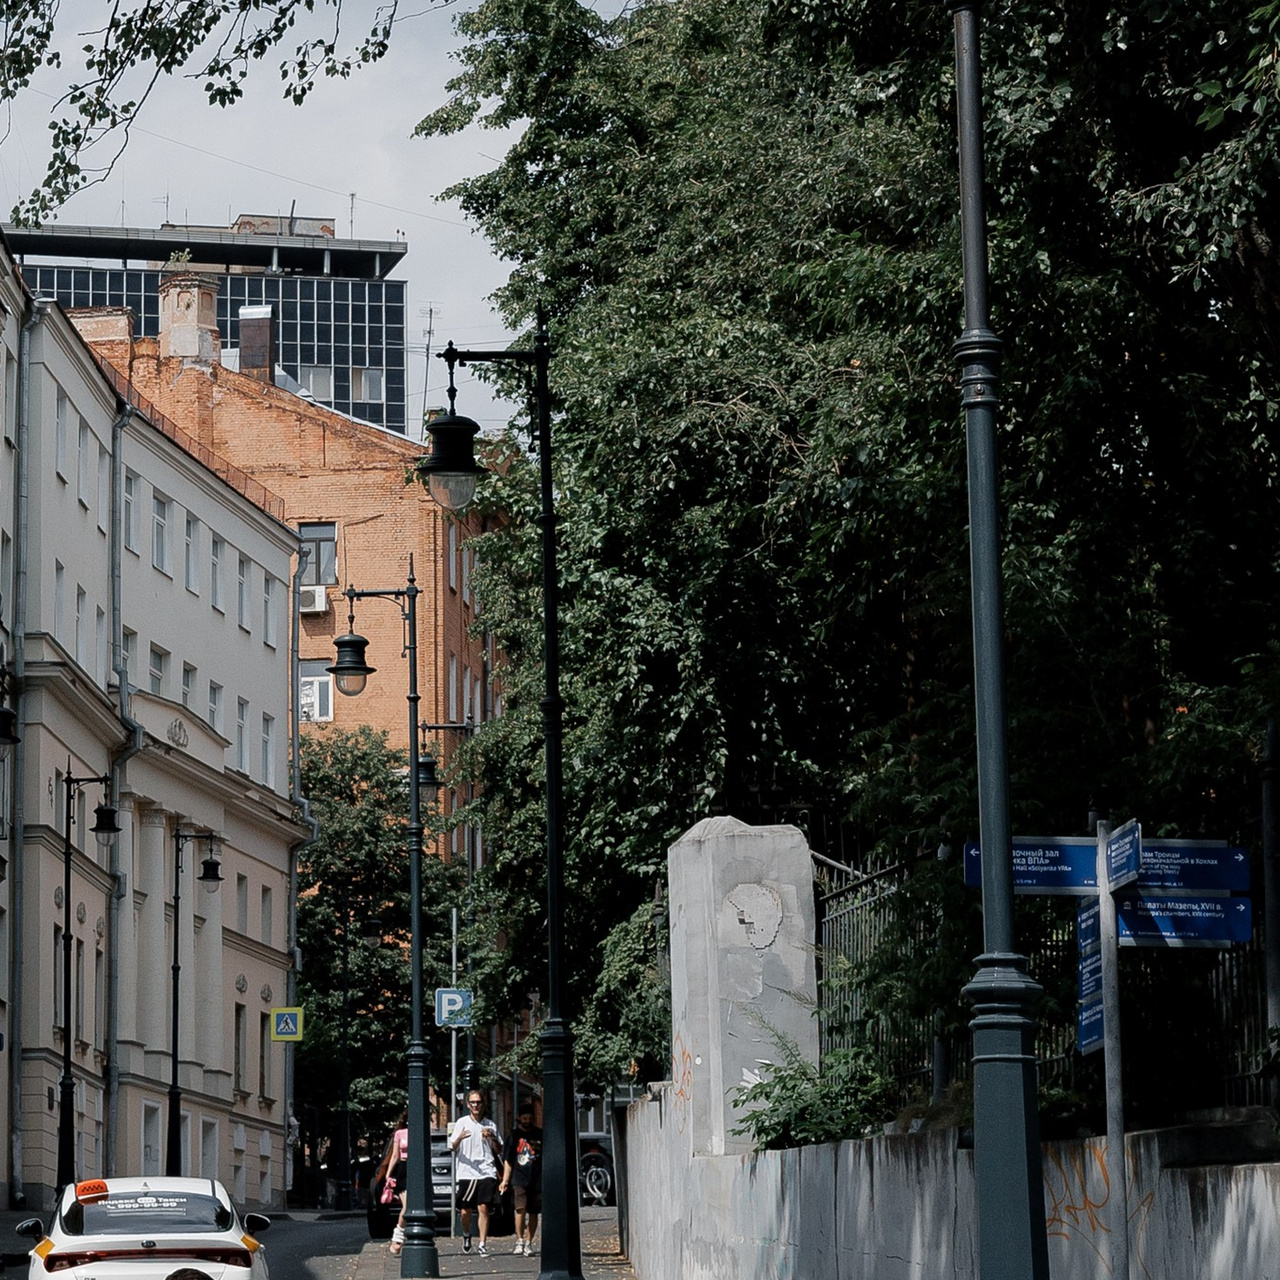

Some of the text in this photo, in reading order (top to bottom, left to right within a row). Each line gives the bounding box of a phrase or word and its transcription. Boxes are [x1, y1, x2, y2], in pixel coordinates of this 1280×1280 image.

[1137, 901, 1166, 909] Палаты
[1167, 902, 1200, 910] Мазепы,
[441, 993, 463, 1021] P
